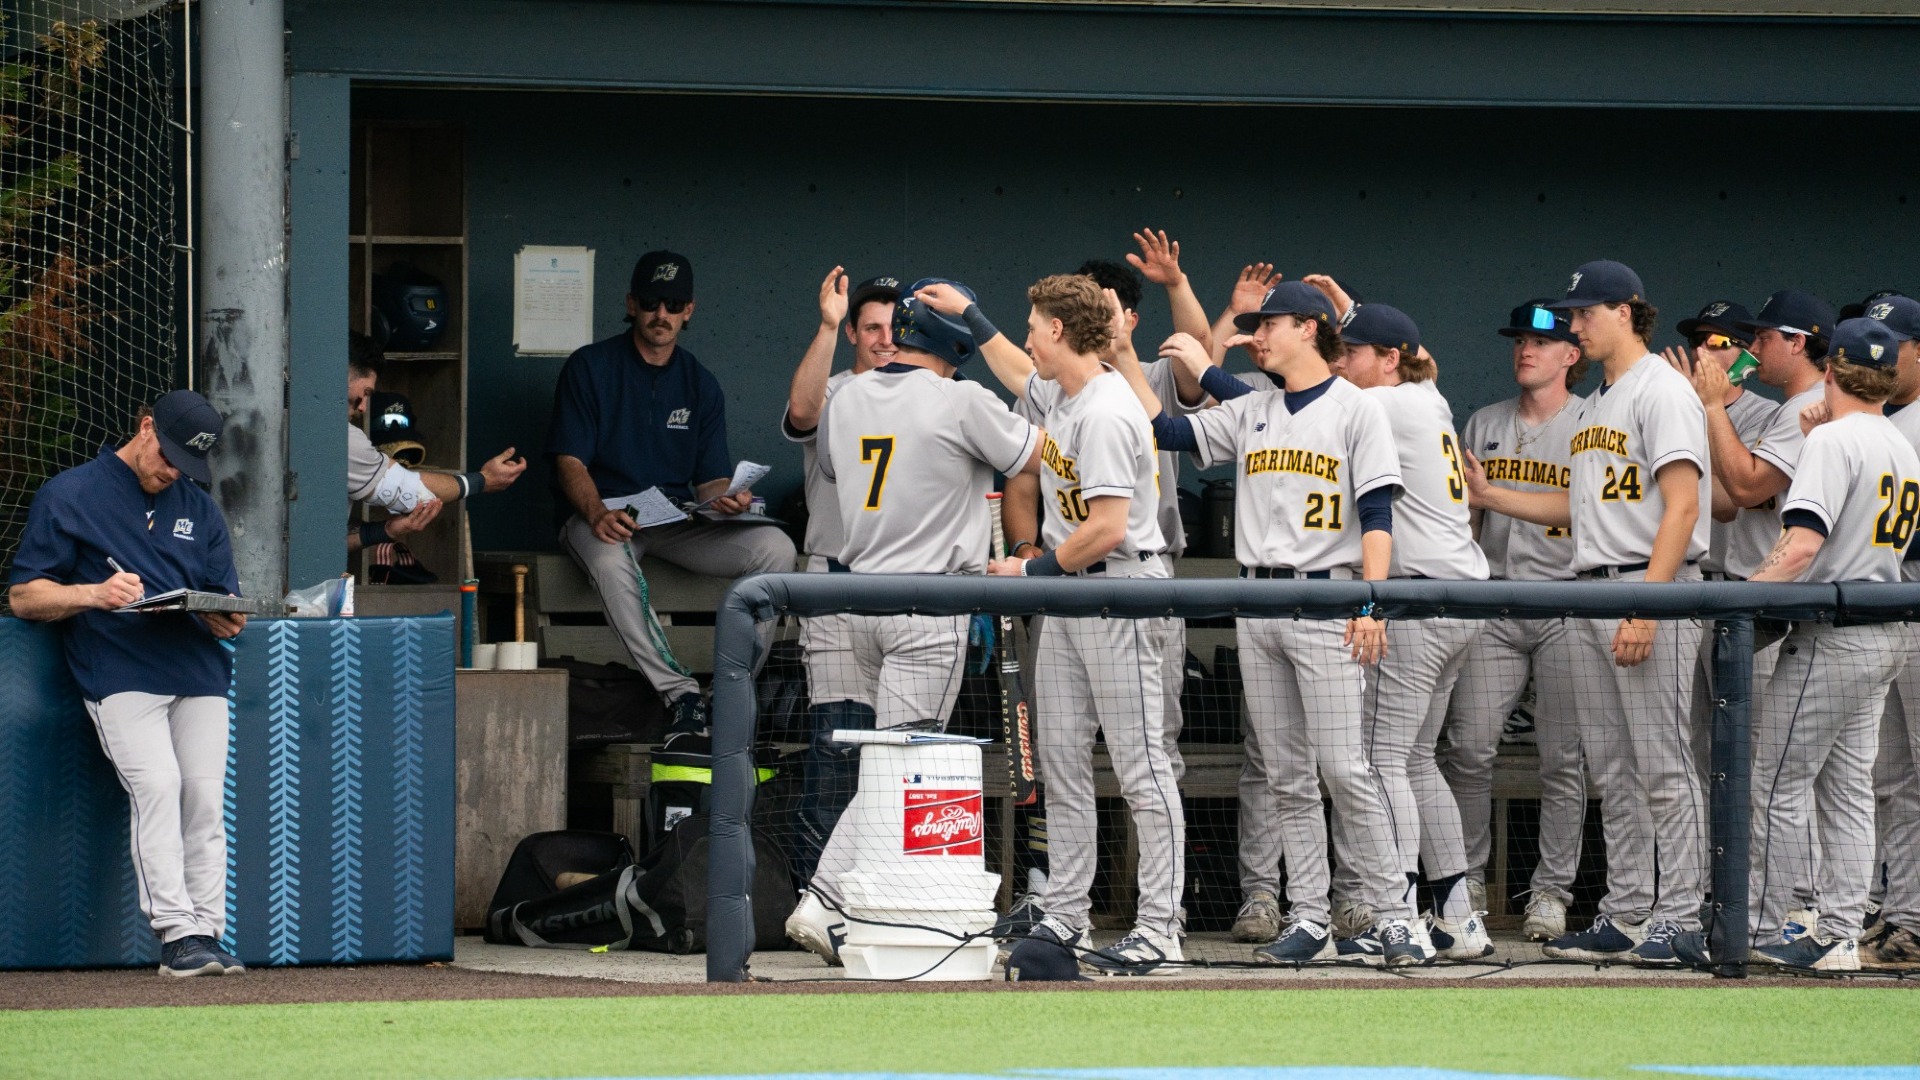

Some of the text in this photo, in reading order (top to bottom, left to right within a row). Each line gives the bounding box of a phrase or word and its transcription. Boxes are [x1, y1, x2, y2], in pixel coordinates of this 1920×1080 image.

[859, 434, 896, 511] 7
[1480, 457, 1570, 489] ERRIMAC
[1601, 463, 1643, 502] 24
[1056, 486, 1090, 522] 30
[1303, 492, 1342, 531] 21
[1871, 472, 1920, 553] 28
[1001, 689, 1018, 798] PERFORMANCE
[911, 811, 981, 842] Rawlings
